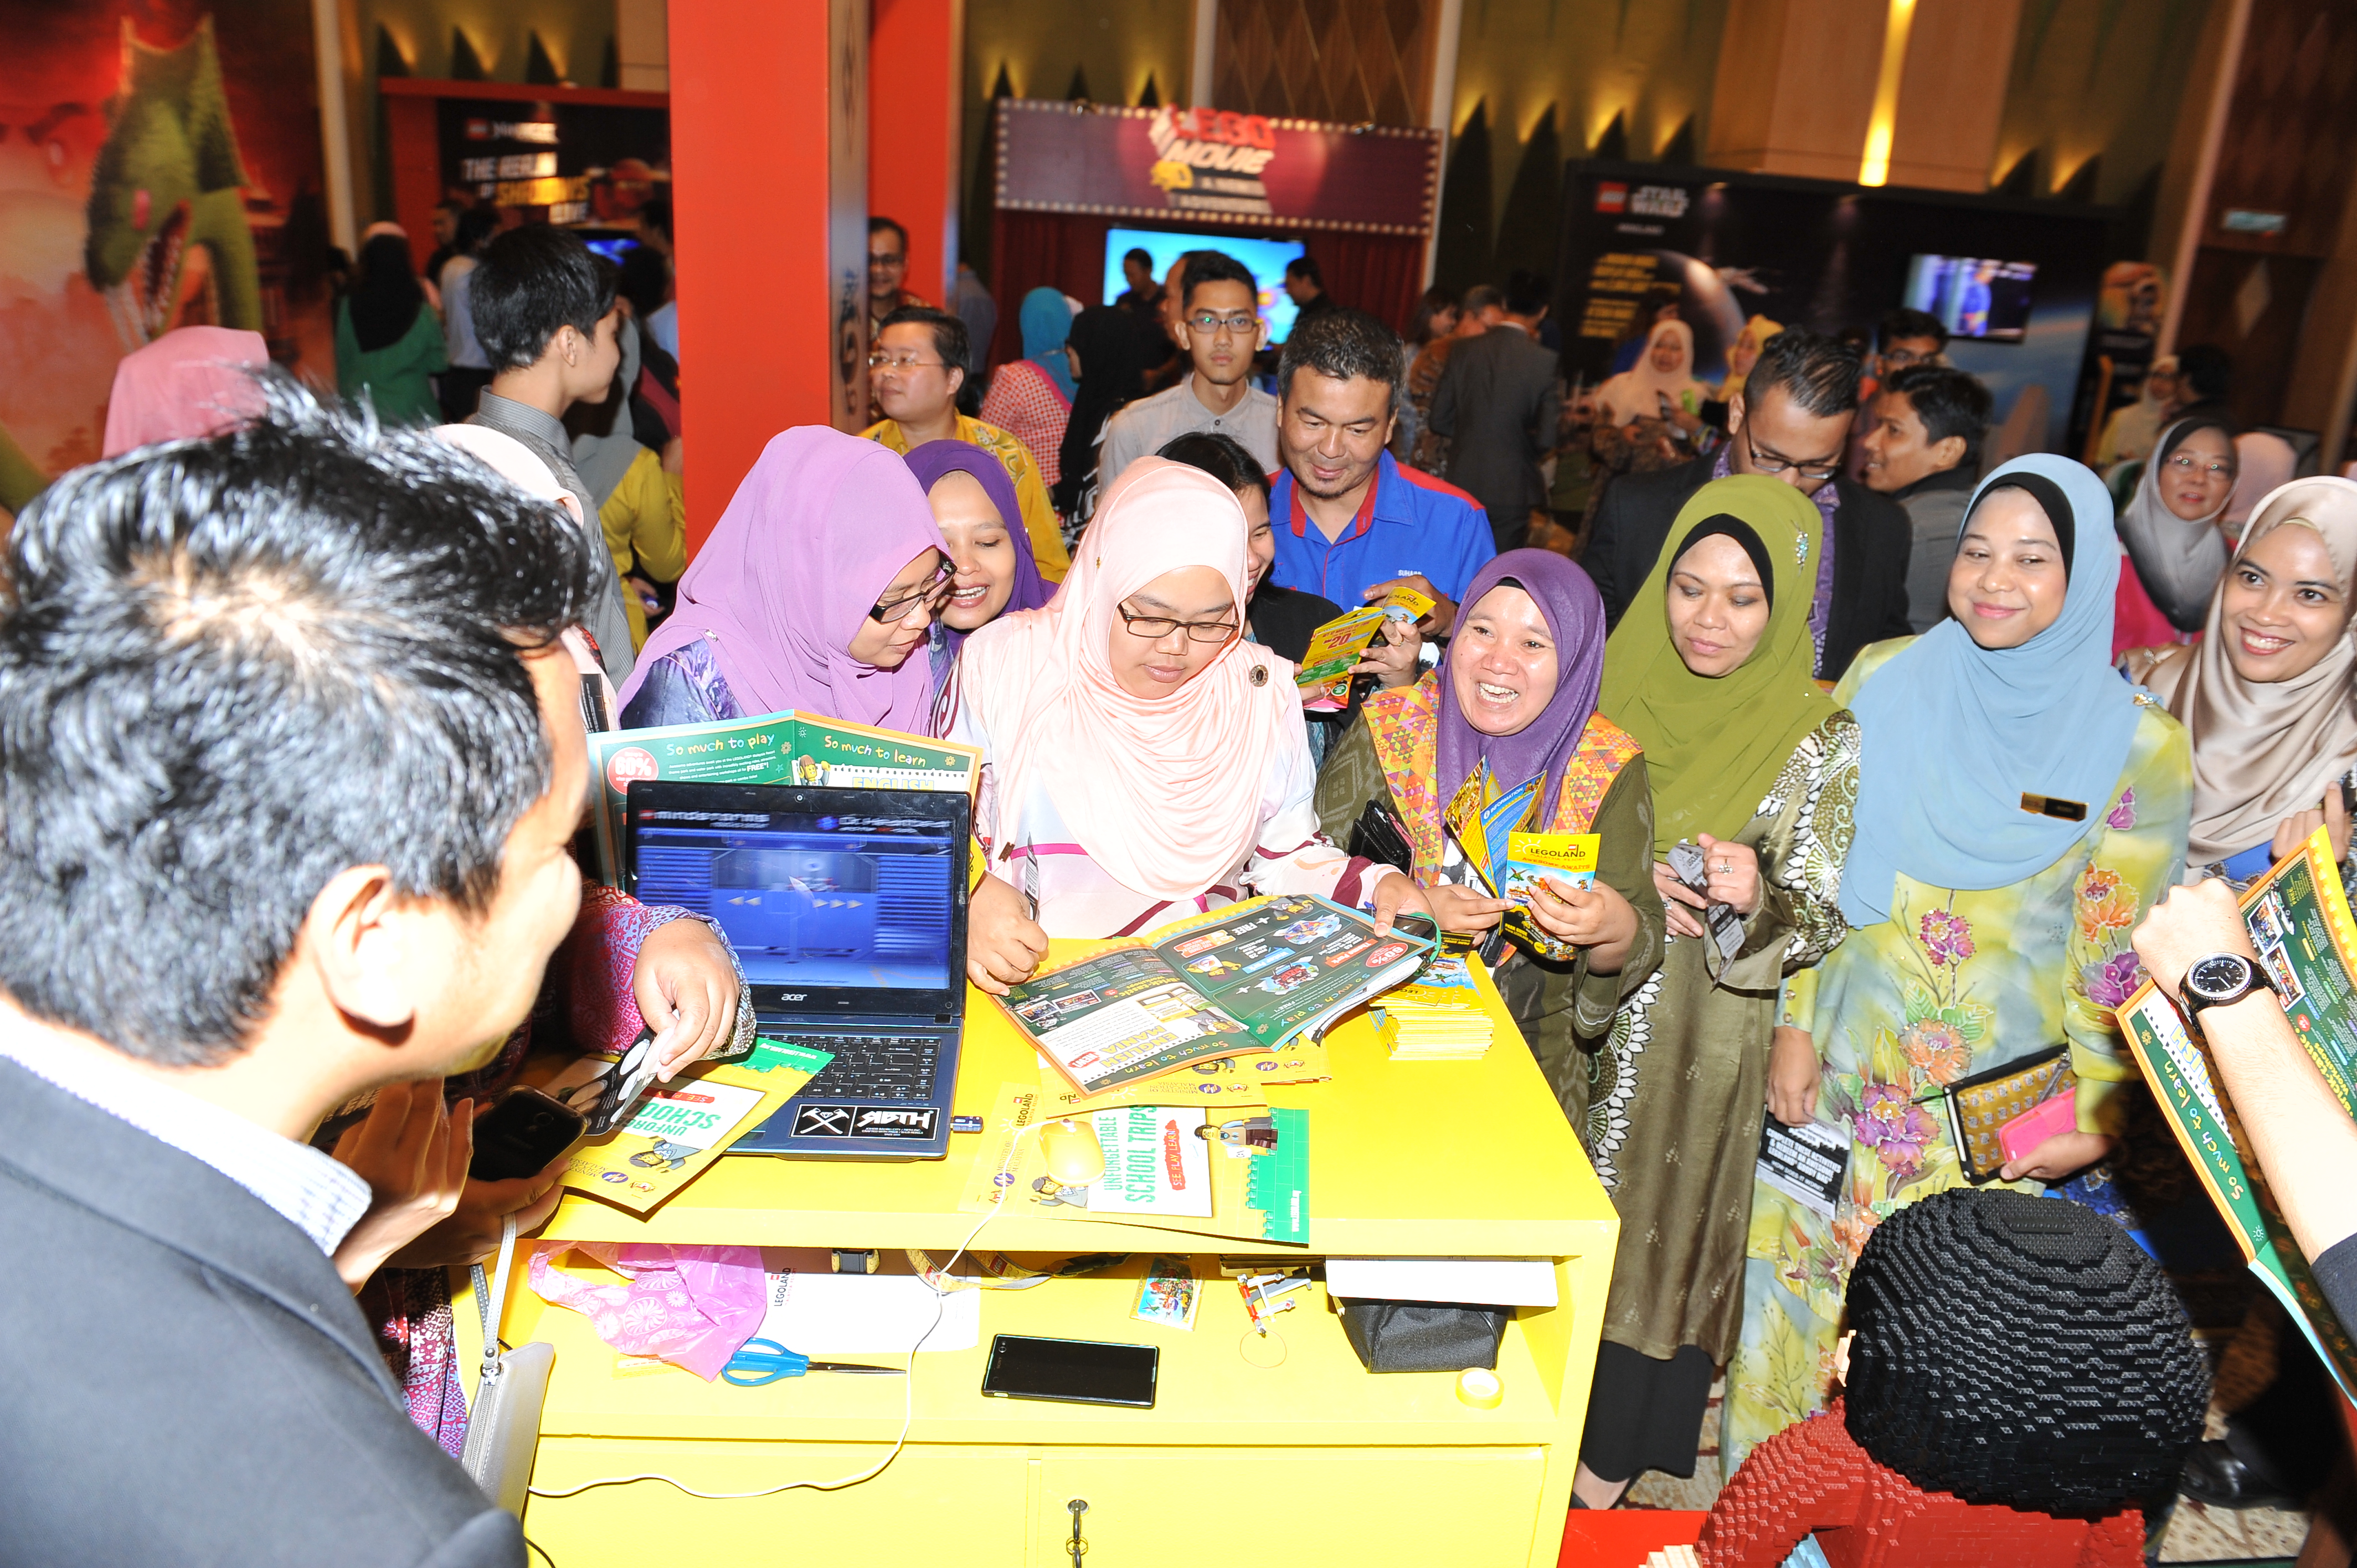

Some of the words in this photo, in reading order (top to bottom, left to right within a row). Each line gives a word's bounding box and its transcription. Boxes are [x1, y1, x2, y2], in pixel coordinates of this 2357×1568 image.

[1163, 139, 1274, 174] MOVIE
[1640, 185, 1687, 200] STAR
[666, 743, 684, 756] So
[688, 739, 723, 754] much
[728, 737, 744, 749] to
[747, 733, 775, 749] play
[825, 735, 838, 749] So
[841, 743, 872, 756] much
[876, 746, 891, 759] to
[894, 749, 926, 767] learn
[615, 756, 652, 776] 60%
[853, 776, 934, 791] ENGLISH
[1490, 787, 1523, 813] INFORMATION
[1530, 844, 1586, 858] LEGOLAND
[1522, 858, 1560, 867] AWESOME
[1232, 922, 1258, 936] FREE
[1265, 952, 1289, 963] Water
[1331, 952, 1350, 964] Park
[1347, 942, 1372, 955] Theme
[1371, 946, 1404, 964] 60%
[1250, 961, 1267, 971] Park
[1355, 973, 1371, 983] So
[1325, 984, 1353, 1003] much
[1308, 1003, 1324, 1012] to
[1280, 1010, 1306, 1027] play
[1099, 1025, 1167, 1054] MANIA
[1099, 1034, 1179, 1067] ENGLISH
[1178, 1044, 1210, 1055] much
[1073, 1053, 1099, 1068] NEW!
[1125, 1059, 1160, 1074] learn
[2314, 1042, 2349, 1096] Workshops
[2164, 1060, 2190, 1108] learn
[1015, 1093, 1034, 1127] LEGOLAND
[2189, 1107, 2202, 1130] to
[1128, 1105, 1157, 1143] TRIPS
[1167, 1128, 1178, 1151] LEARN!
[1098, 1116, 1123, 1190] UNFORGETTABLE
[1766, 1127, 1794, 1148] COMPLETE
[1794, 1142, 1812, 1157] THESE
[1811, 1151, 1842, 1174] ACTIVITIES
[1776, 1141, 1798, 1158] REDEEM
[1805, 1157, 1835, 1179] AWESOME
[2202, 1131, 2231, 1174] much
[1012, 1148, 1025, 1173] MALAYSIA
[1170, 1152, 1181, 1170] PLAY,
[1797, 1162, 1817, 1178] GOODY
[1125, 1148, 1156, 1203] SCHOOL
[1172, 1172, 1183, 1186] SEE,
[1784, 1167, 1799, 1179] DOES
[2229, 1177, 2243, 1200] So
[772, 1267, 791, 1306] LEGOLAND
